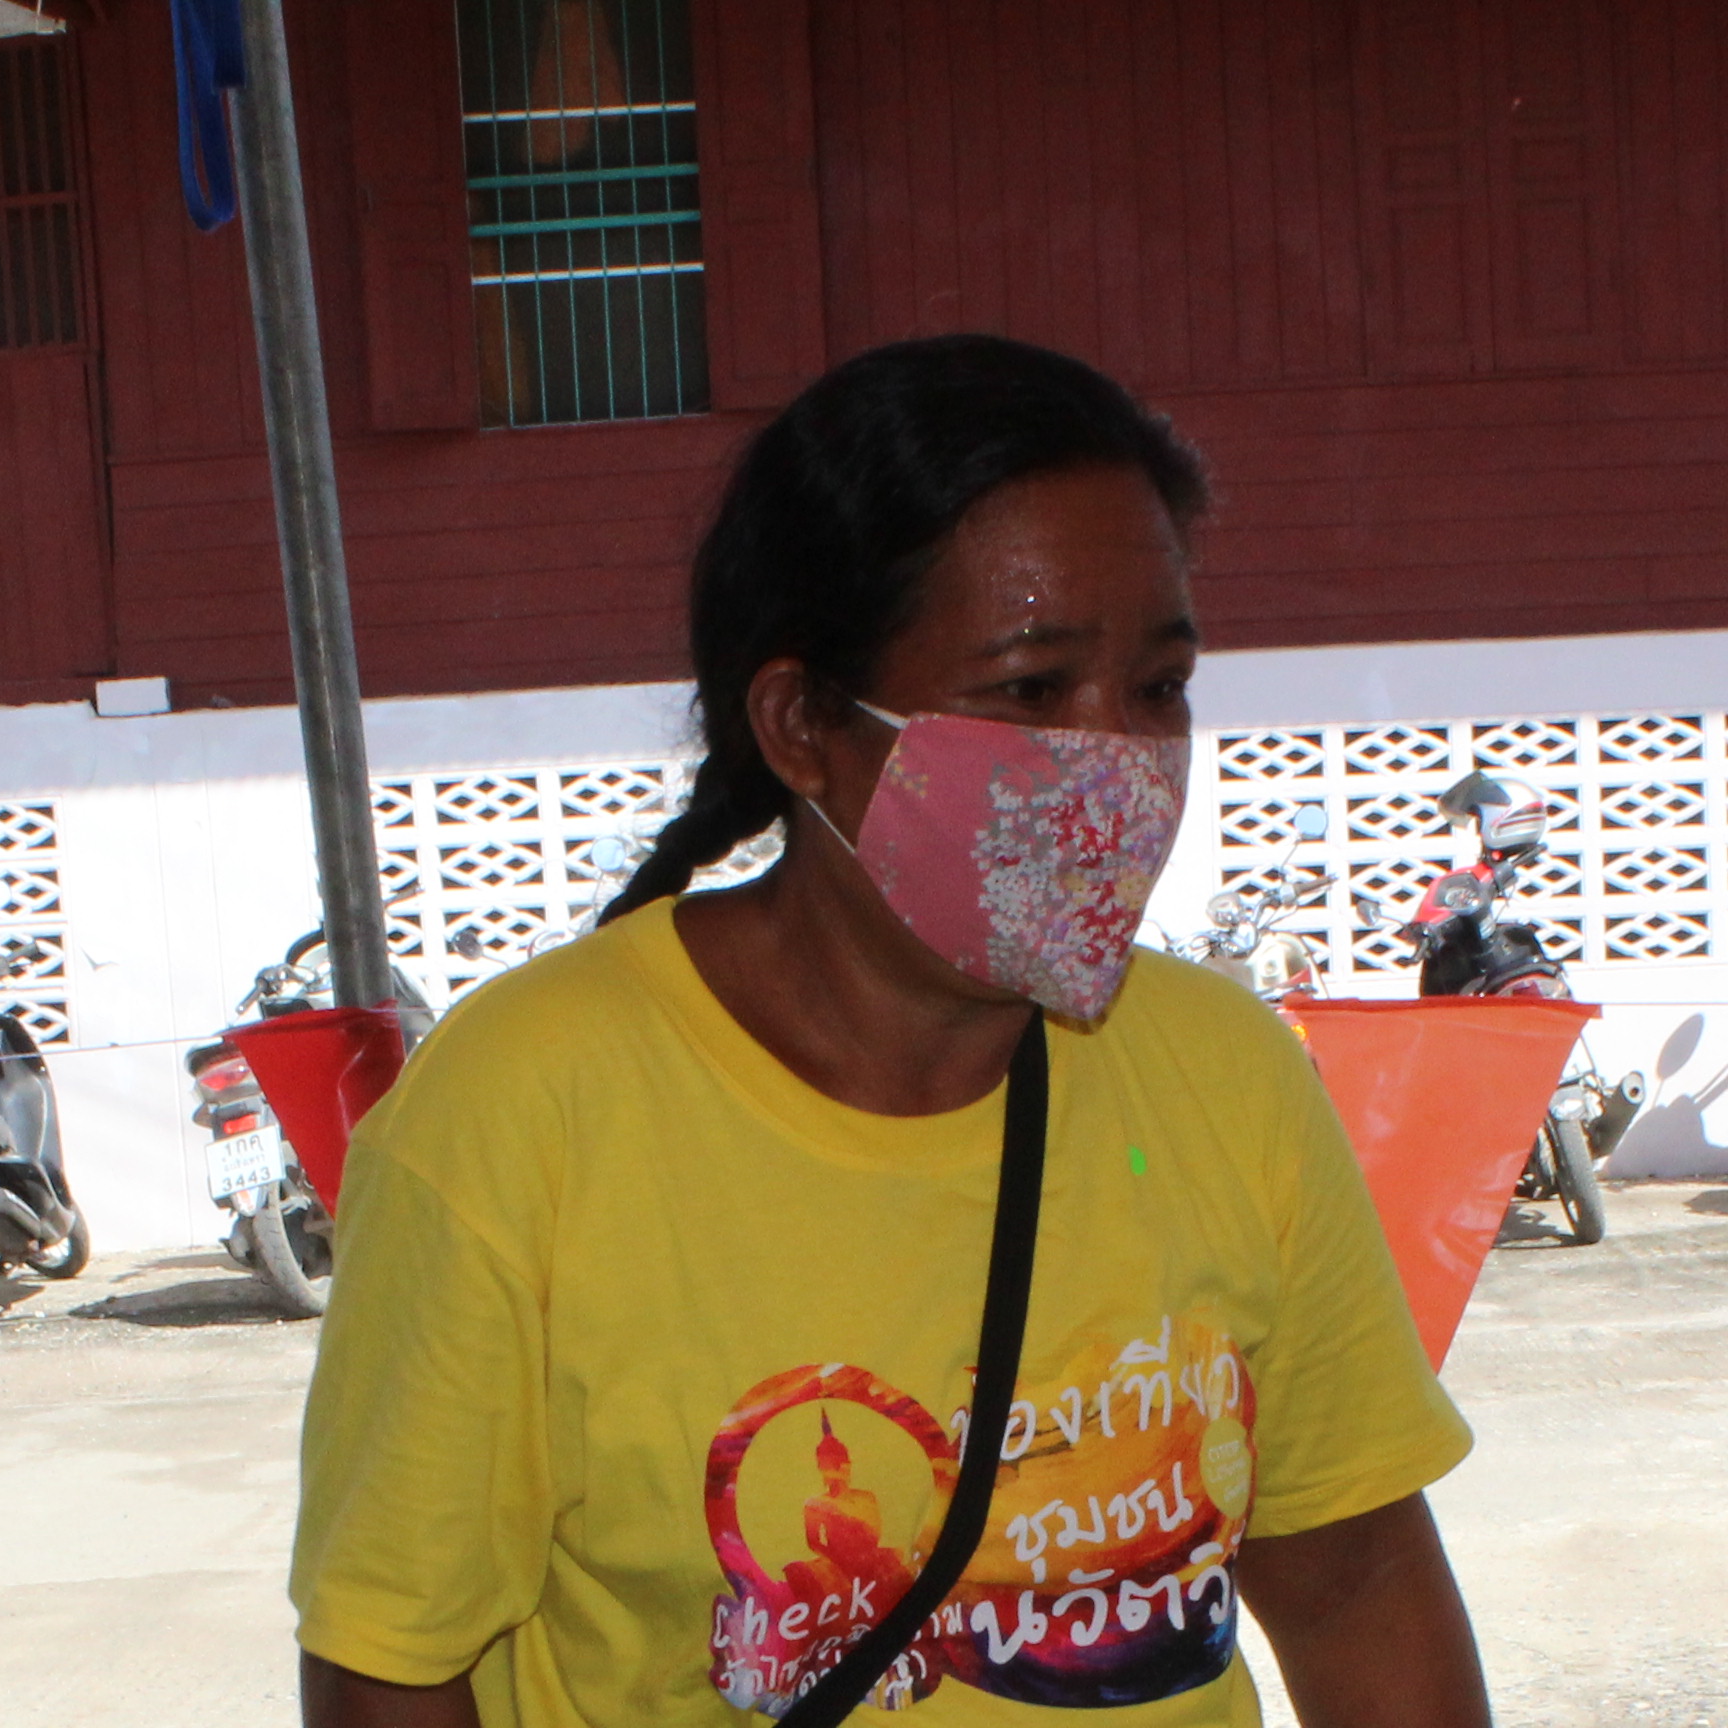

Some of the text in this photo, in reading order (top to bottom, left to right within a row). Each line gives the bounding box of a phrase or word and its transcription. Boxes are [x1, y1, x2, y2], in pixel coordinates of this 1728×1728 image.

[221, 1166, 271, 1192] 3443
[950, 1313, 1240, 1467] องเที่ยว
[1005, 1461, 1194, 1583] ชุมชน
[713, 1576, 876, 1649] Check
[970, 1532, 1238, 1665] นวัตวิ
